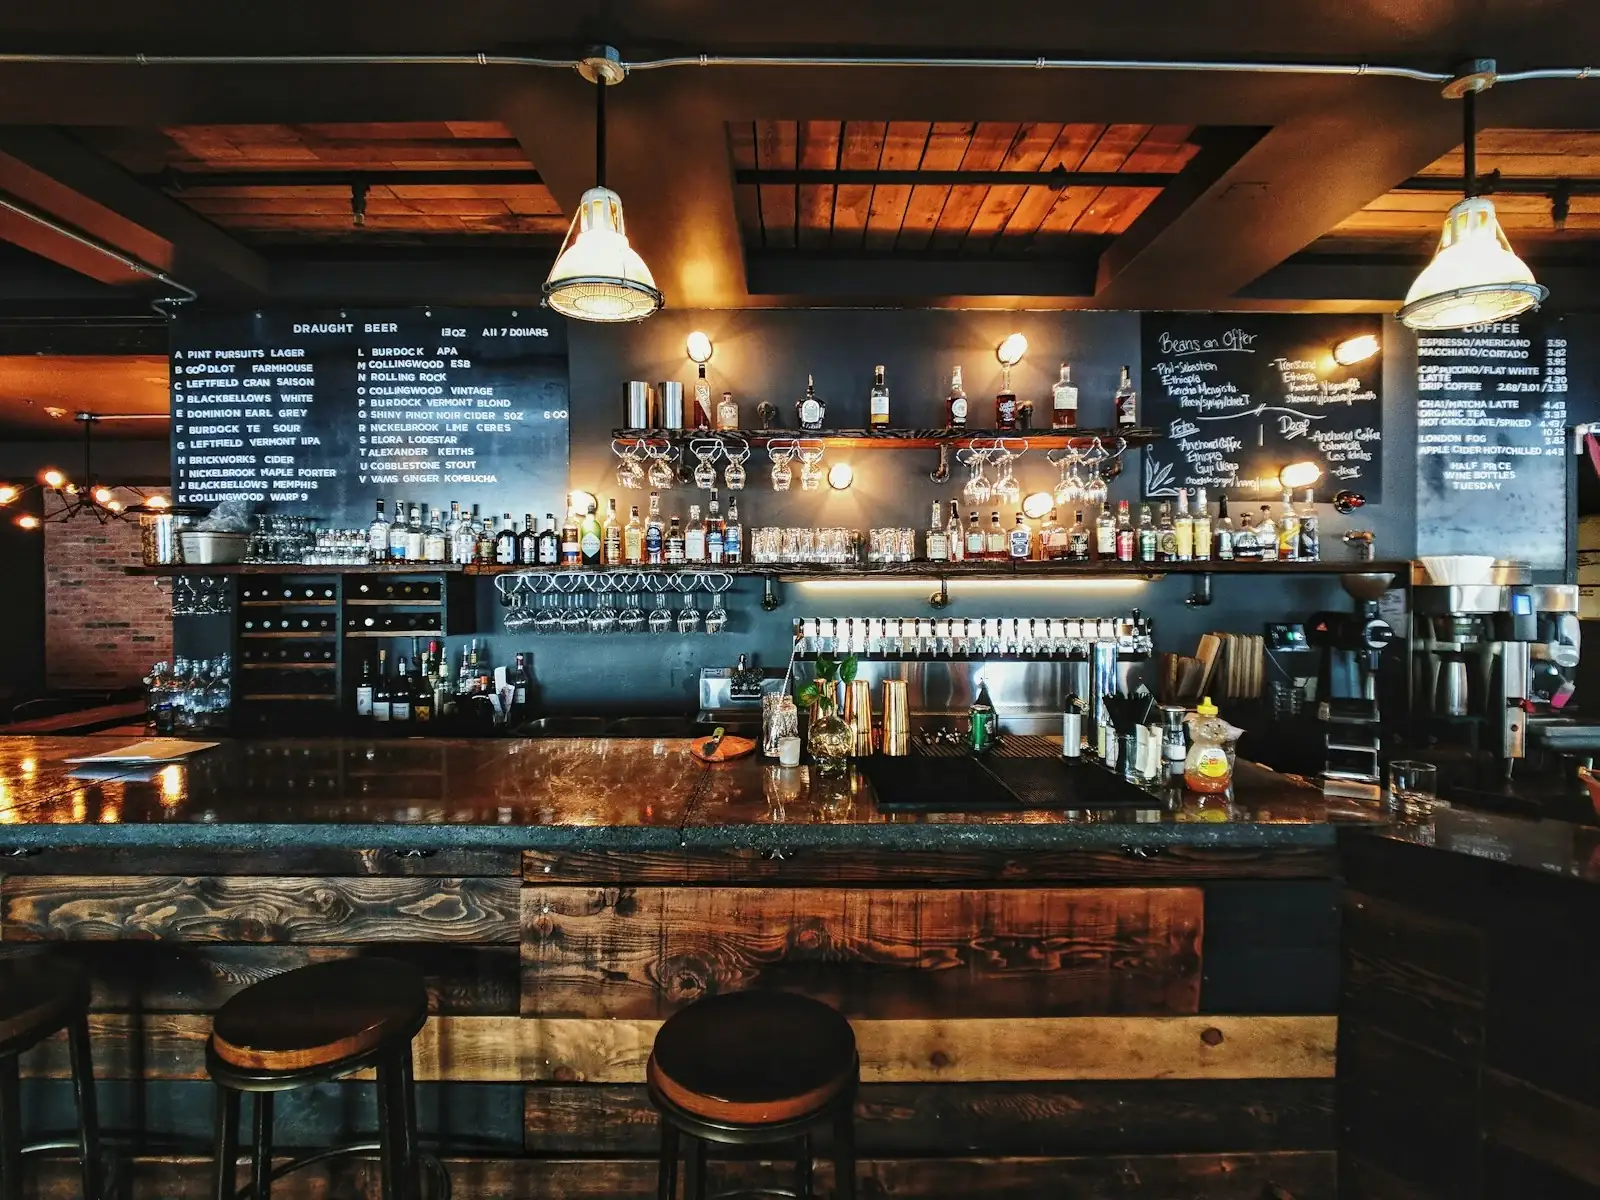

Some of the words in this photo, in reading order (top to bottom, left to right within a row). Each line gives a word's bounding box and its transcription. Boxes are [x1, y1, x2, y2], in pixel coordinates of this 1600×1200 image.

[293, 324, 353, 333] DRAUGHT
[365, 324, 398, 333] BEER
[501, 329, 507, 337] 7
[1464, 323, 1519, 334] COFFEE
[1159, 332, 1201, 353] Beans
[1204, 339, 1219, 348] on
[1222, 328, 1258, 350] Offer
[1418, 338, 1530, 347] ESPRESSO/AMERICANO
[1547, 339, 1567, 347] 3.50
[175, 351, 183, 359] A
[188, 351, 211, 359] PINT
[215, 350, 264, 358] PURSUITS
[271, 349, 304, 357] LAGER
[372, 348, 424, 356] BURDOCK
[437, 347, 458, 356] APA
[1418, 348, 1529, 358] MACCHIATO/CORTADO
[175, 366, 182, 374] B
[252, 364, 313, 373] FARMHOUSE
[357, 362, 366, 370] M
[369, 360, 444, 369] COLLINGWOOD
[450, 360, 470, 368] ESB
[1508, 367, 1539, 375] WHITE
[358, 374, 366, 382] N
[371, 373, 415, 382] ROLLING
[420, 373, 447, 382] ROCK
[1162, 374, 1201, 386] Ethiopia
[1419, 374, 1451, 382] LATTE
[174, 382, 181, 390] C
[187, 379, 238, 388] LEFTFIELD
[243, 379, 270, 387] CRAN
[276, 378, 314, 386] SAISON
[1419, 383, 1443, 391] DRIP
[357, 387, 365, 395] O
[369, 387, 442, 395] COLLINGWOOD
[451, 387, 493, 395] VINTAGE
[187, 394, 271, 403] BLACKBELLOWS
[359, 399, 365, 407] P
[371, 399, 421, 407] BURDOCK
[427, 399, 473, 407] VERMONT
[477, 399, 511, 408] BLOND
[1489, 400, 1519, 409] LATTE
[187, 410, 241, 418] DOMINION
[278, 409, 307, 417] GREY
[358, 411, 367, 419] Q
[370, 411, 402, 419] SHINY
[406, 411, 433, 420] PINOT
[436, 412, 460, 420] NOIR
[464, 411, 495, 420] CIDER
[1418, 410, 1464, 418] ORGANIC
[1419, 418, 1439, 427] HOT
[1440, 418, 1531, 427] CHOCOLATE/SPIKED
[176, 425, 183, 433] F
[189, 425, 239, 434] BURDOCK
[246, 425, 260, 433] TE
[273, 425, 301, 433] SOUR
[359, 424, 366, 432] R
[371, 424, 438, 432] NICKELBROOK
[446, 424, 468, 432] LIME
[477, 424, 511, 432] CERES
[177, 442, 185, 450] G
[191, 439, 243, 448] LEFTFIELD
[250, 437, 296, 446] VERMONT
[360, 436, 366, 444] S
[371, 436, 402, 444] ELORA
[409, 435, 457, 444] LODESTAR
[1419, 435, 1461, 443] LONDON
[1465, 435, 1487, 443] FOG
[360, 448, 367, 456] T
[368, 448, 428, 456] ALEXANDER
[438, 448, 474, 456] KEITHS
[1419, 446, 1449, 455] APPLE
[1452, 446, 1483, 454] CIDER
[1483, 447, 1542, 455] HOT/CHILLED
[189, 456, 256, 464] BRICKWORKS
[264, 456, 294, 464] CIDER
[1186, 451, 1222, 462] Ethiopia
[1327, 452, 1345, 461] Los
[360, 462, 367, 470] U
[370, 461, 440, 470] COBBLESTONE
[445, 461, 476, 469] STOUT
[1451, 462, 1477, 470] HALF
[1483, 462, 1511, 470] PRICE
[189, 469, 255, 478] NICKELBROOK
[261, 468, 293, 477] MAPLE
[298, 469, 336, 477] PORTER
[359, 475, 367, 483] V
[403, 475, 439, 483] GINGER
[444, 474, 497, 483] KOMBUCHA
[179, 482, 185, 490] J
[188, 481, 268, 490] BLACKBELLOWS
[273, 481, 318, 489] MEMPHIS
[1453, 482, 1502, 490] TUESDAY
[179, 495, 186, 503] K
[189, 493, 264, 502] COLLINGWOOD
[270, 493, 299, 501] WARP
[301, 493, 308, 501] 9
